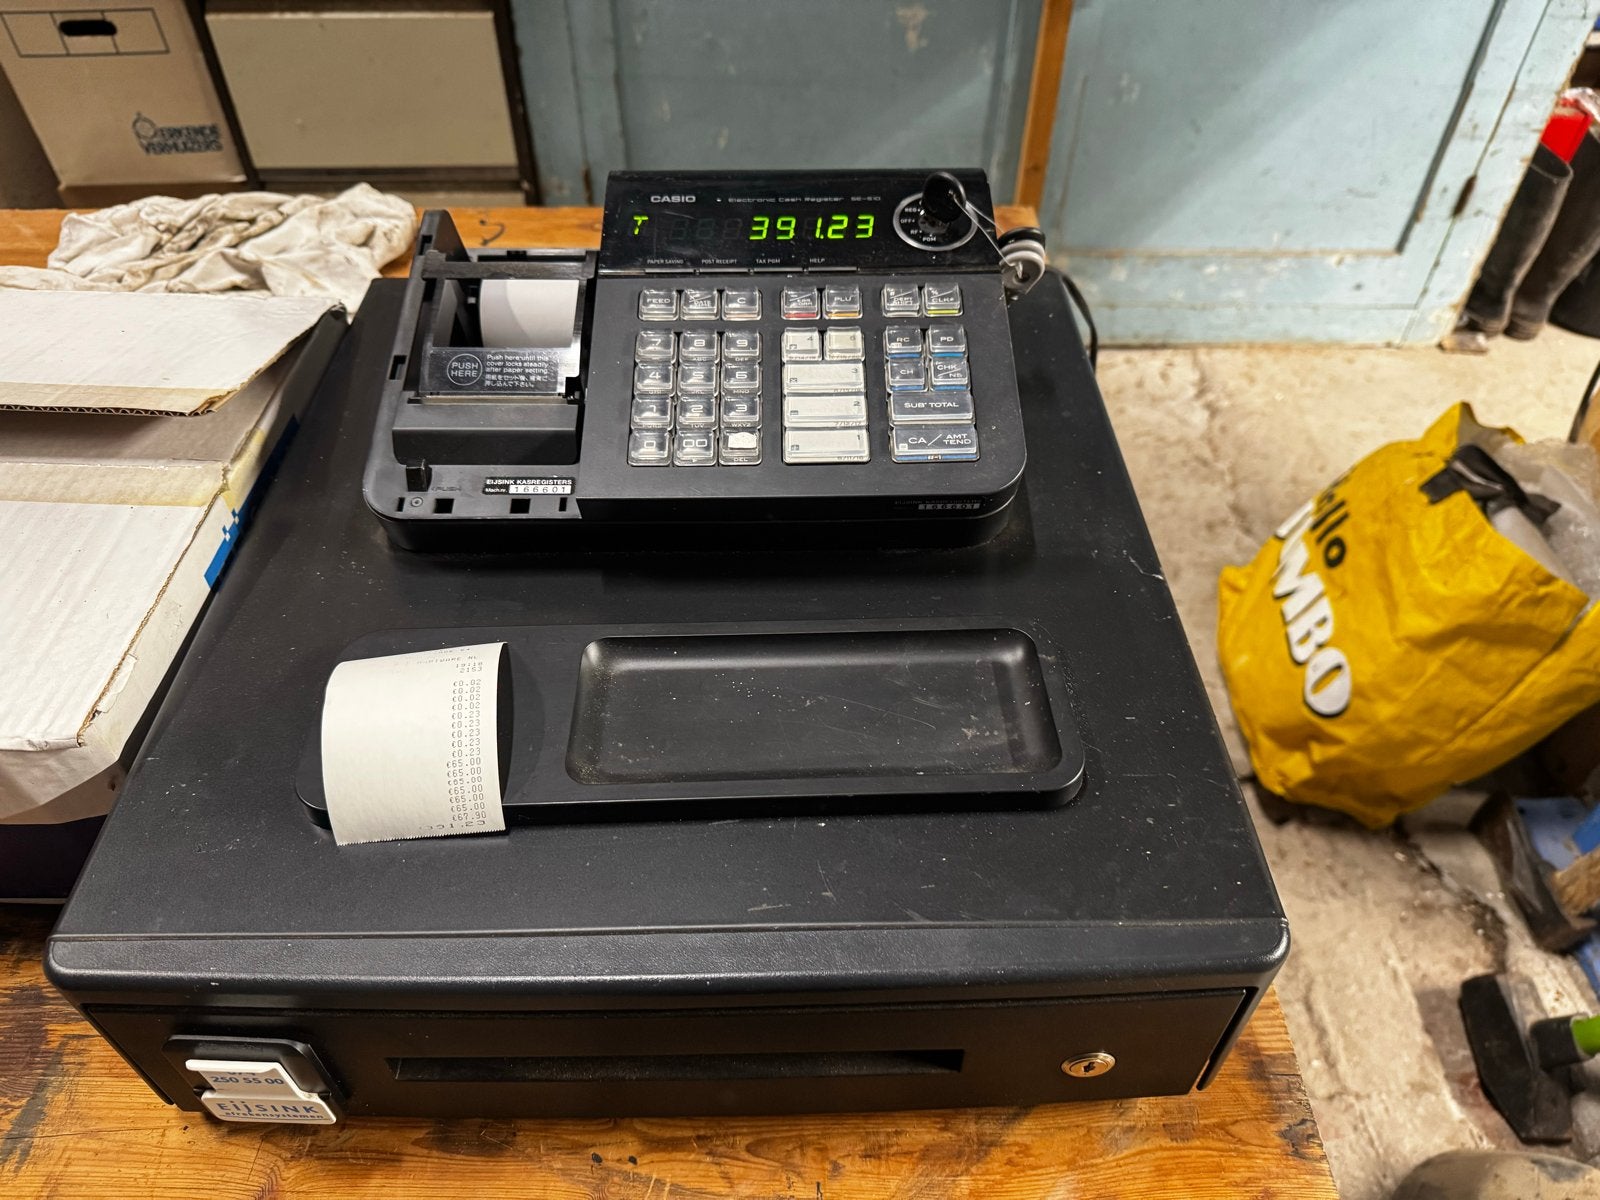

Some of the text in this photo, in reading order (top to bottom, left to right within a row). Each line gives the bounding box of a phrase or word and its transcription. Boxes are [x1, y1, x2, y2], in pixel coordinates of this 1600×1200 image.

[650, 195, 696, 203] CASIO
[694, 339, 706, 347] 8
[736, 339, 748, 347] 9
[523, 361, 549, 369] steadily
[692, 371, 704, 379] 5
[735, 371, 748, 379] 6
[691, 405, 703, 413] 2
[735, 404, 748, 412] 3
[644, 440, 656, 449] 0
[683, 439, 707, 447] 00
